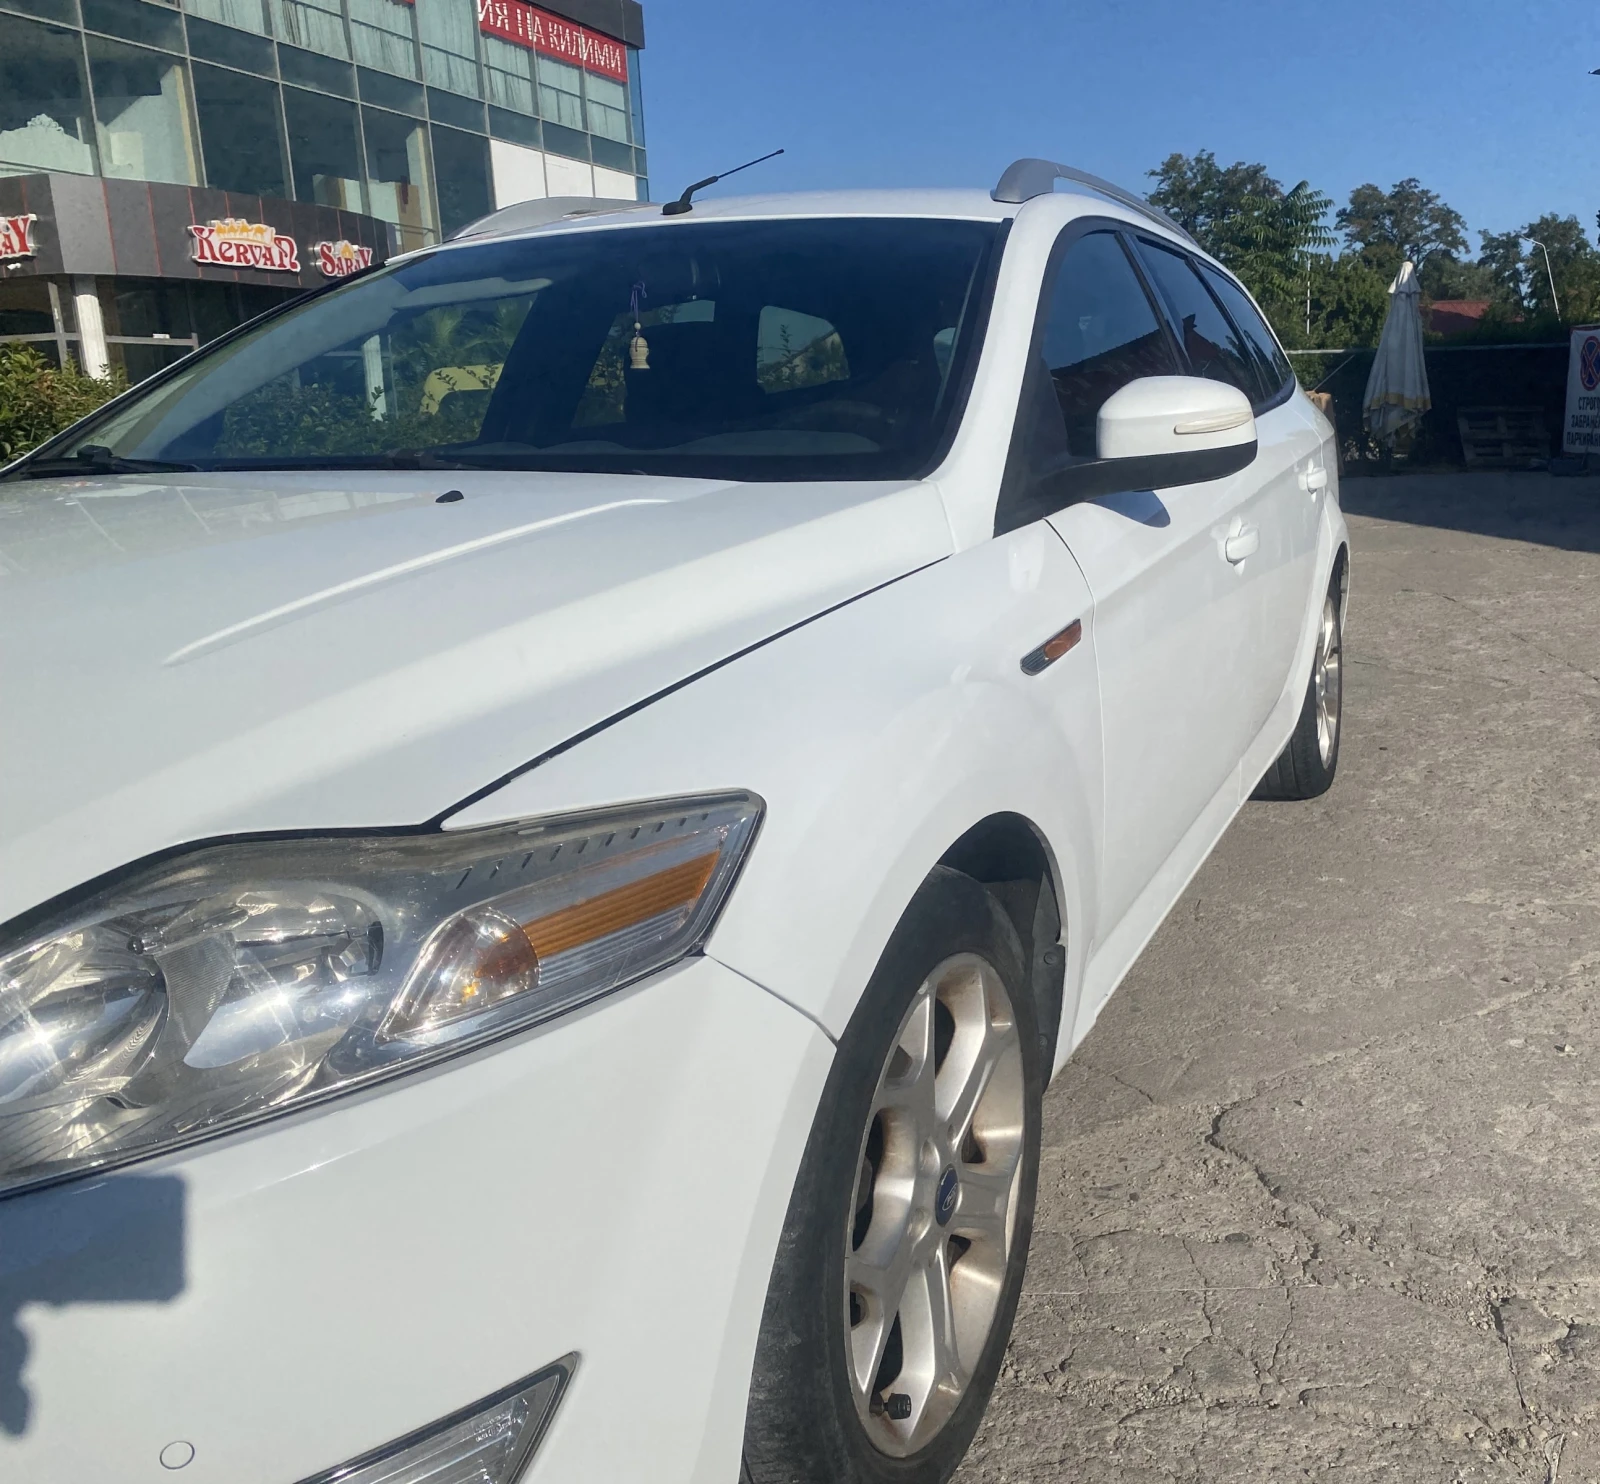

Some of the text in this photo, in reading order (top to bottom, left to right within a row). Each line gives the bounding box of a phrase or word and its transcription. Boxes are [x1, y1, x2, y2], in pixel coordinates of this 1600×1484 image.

[517, 8, 546, 46] НА
[548, 21, 622, 74] КИЛИМИ
[0, 217, 31, 256] AY
